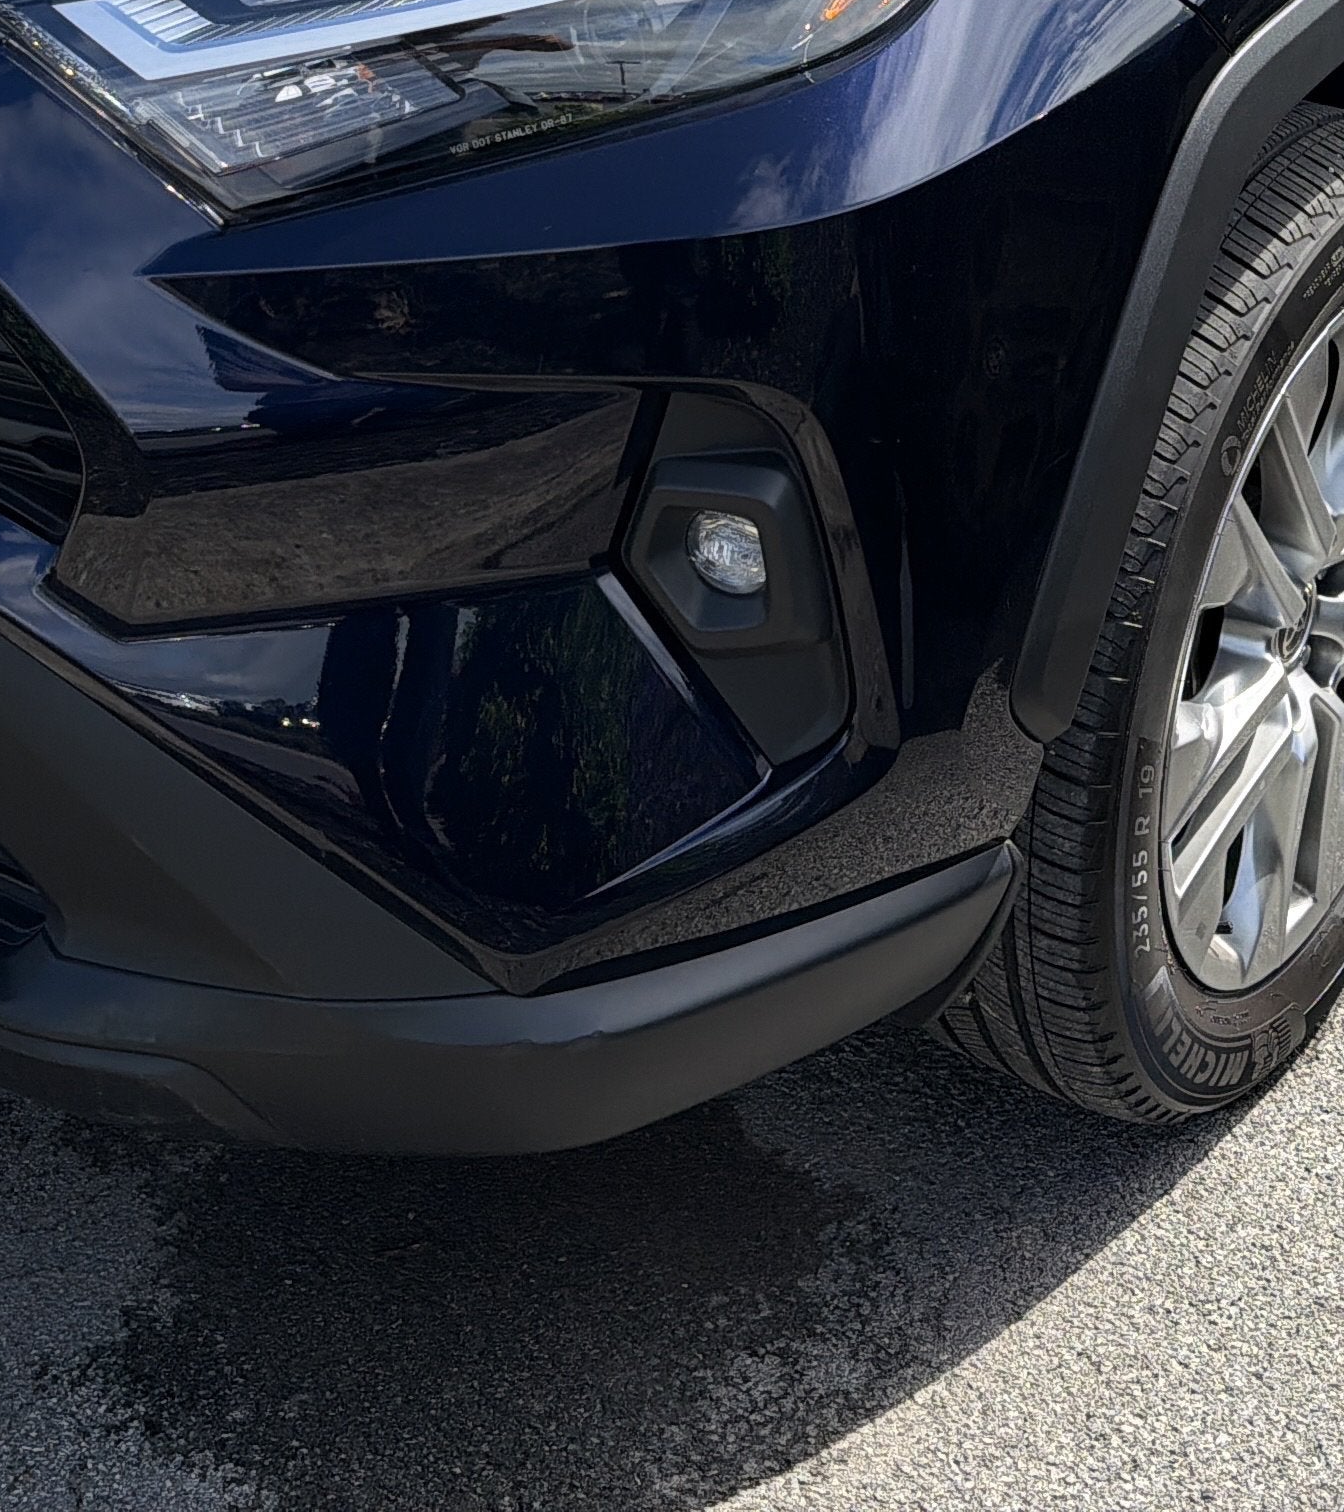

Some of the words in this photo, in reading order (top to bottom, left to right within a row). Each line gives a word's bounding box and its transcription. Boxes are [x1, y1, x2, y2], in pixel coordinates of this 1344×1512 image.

[472, 136, 491, 149] DOT
[495, 124, 537, 143] STANLEY
[1138, 764, 1155, 799] 19
[1134, 815, 1151, 836] R
[1132, 849, 1151, 960] 235/55
[1146, 994, 1250, 1088] MICHELI
